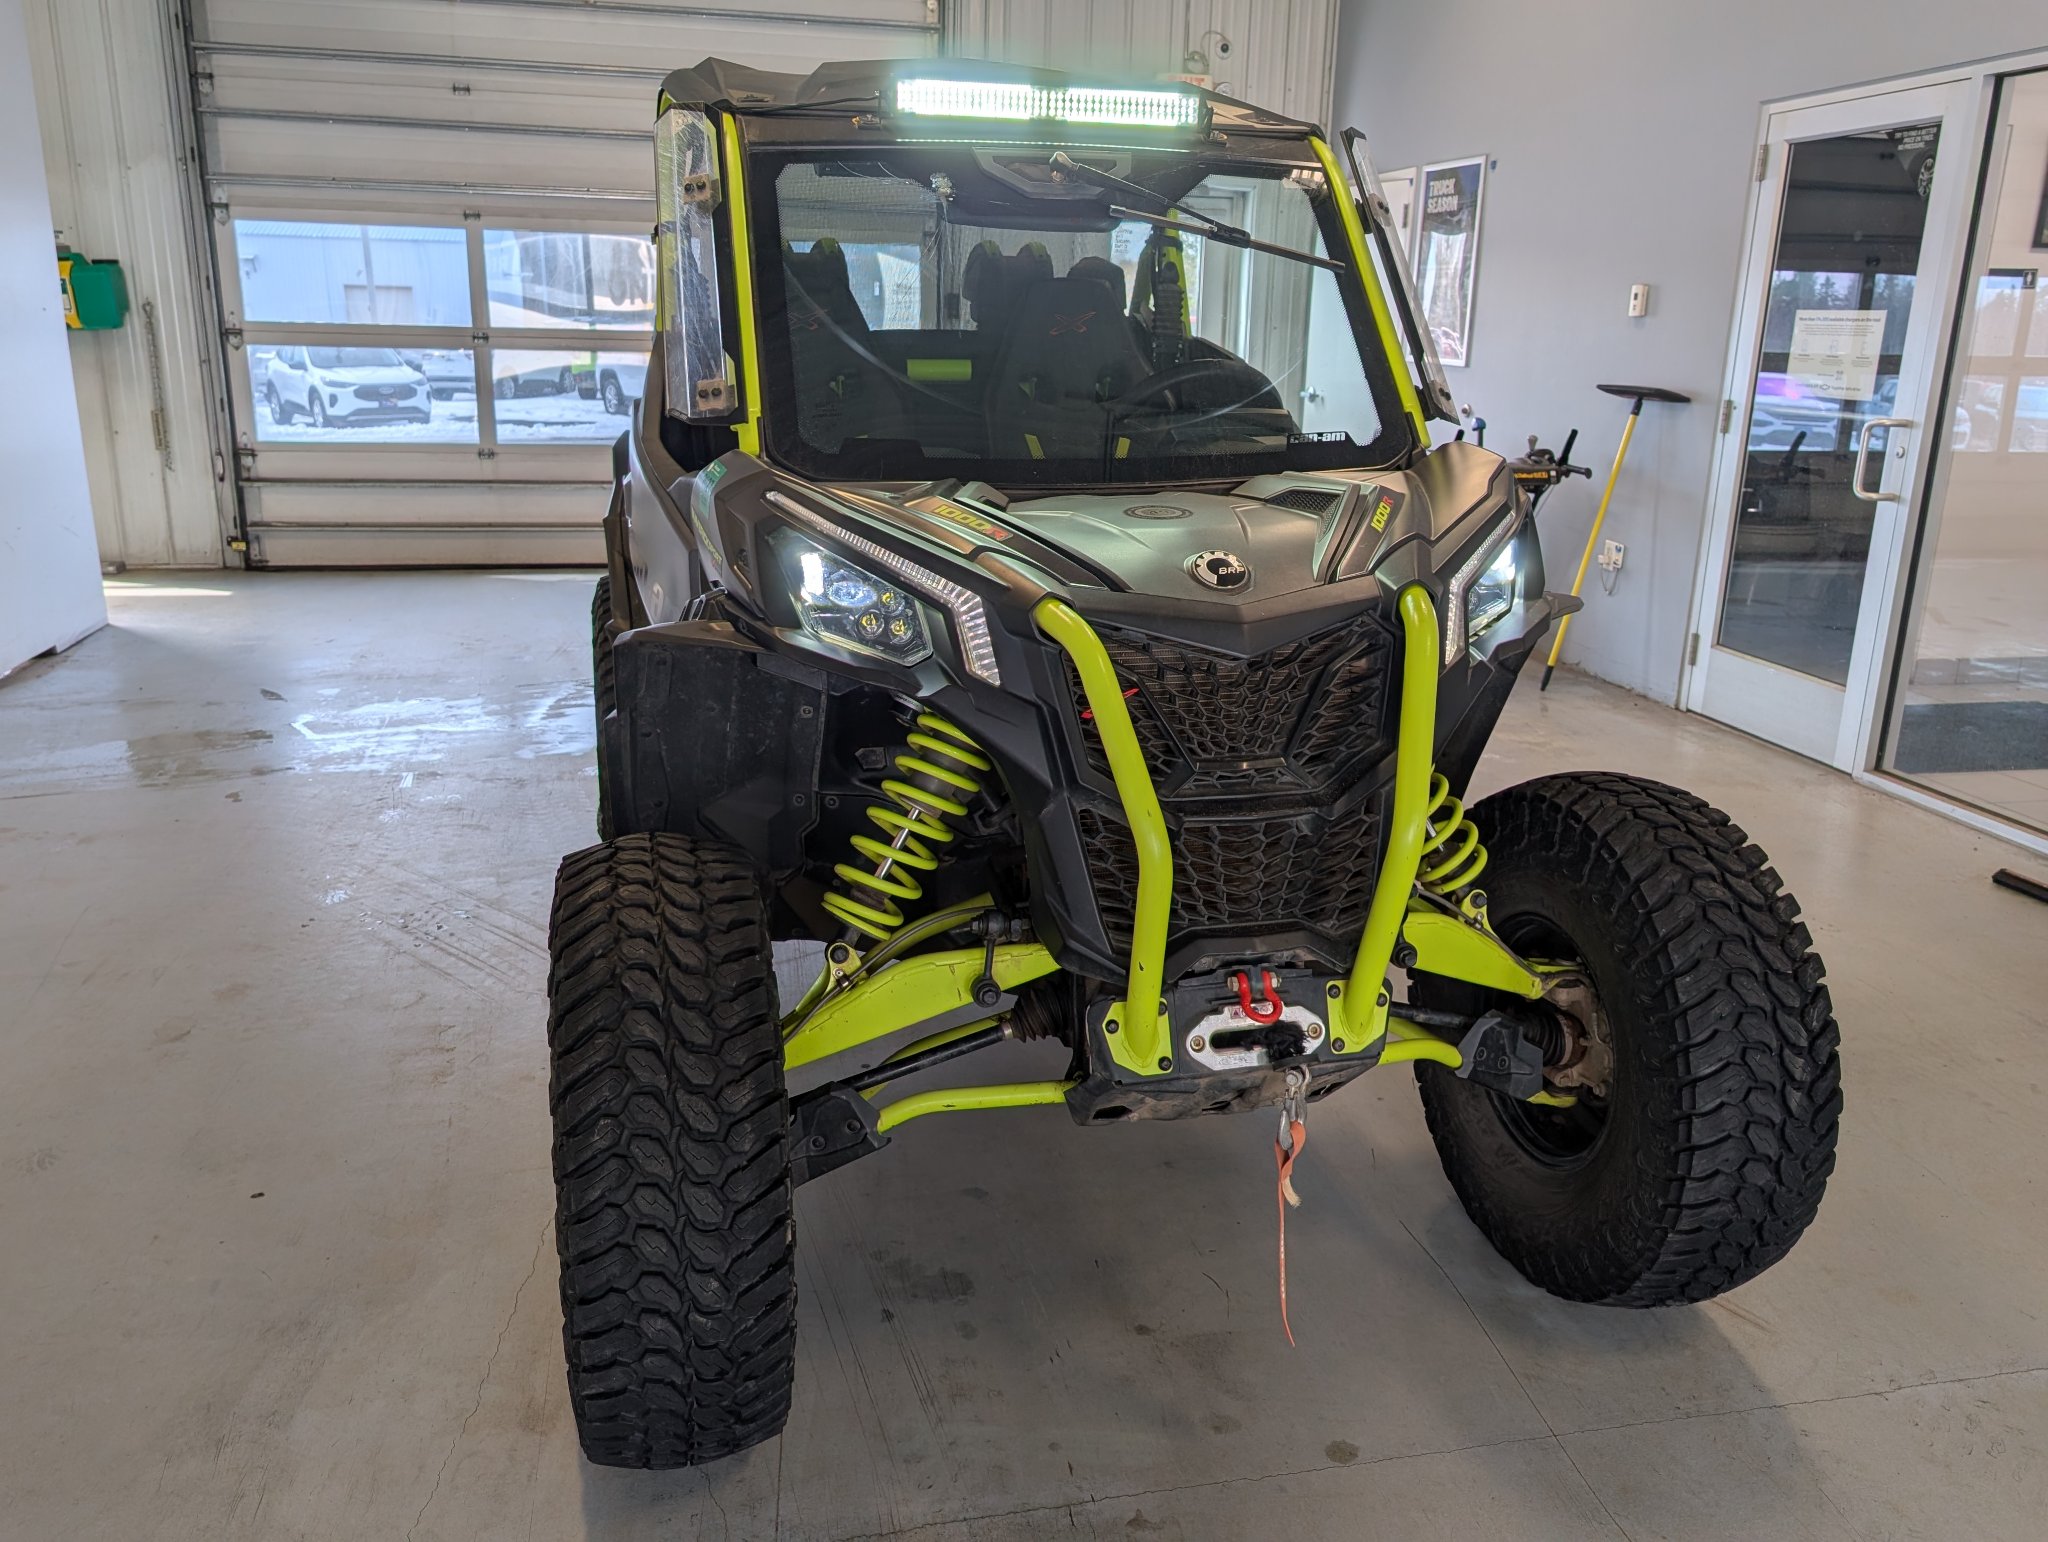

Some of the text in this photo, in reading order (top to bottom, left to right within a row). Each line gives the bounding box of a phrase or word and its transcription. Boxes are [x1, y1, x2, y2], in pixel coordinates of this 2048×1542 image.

[1429, 178, 1456, 196] TRUCK
[1427, 195, 1459, 214] SEASON
[1290, 432, 1346, 443] can-am
[933, 505, 1010, 541] 1000R
[1370, 495, 1394, 533] 1000R
[1218, 566, 1244, 575] BRP
